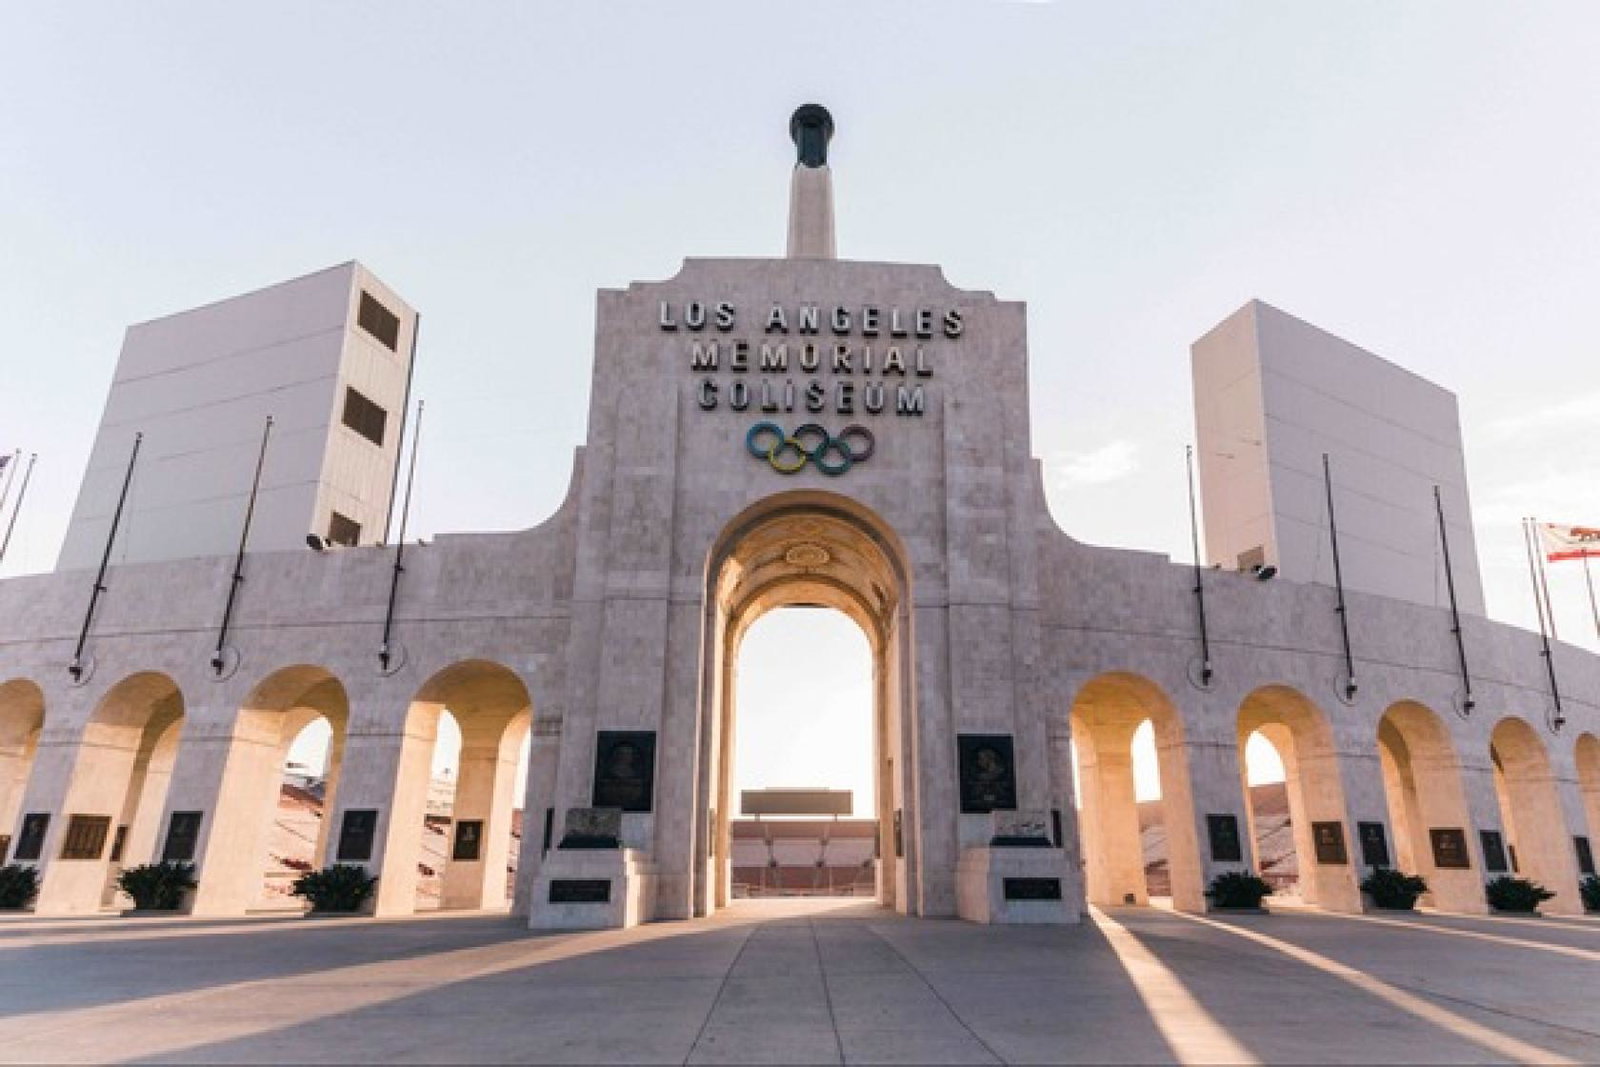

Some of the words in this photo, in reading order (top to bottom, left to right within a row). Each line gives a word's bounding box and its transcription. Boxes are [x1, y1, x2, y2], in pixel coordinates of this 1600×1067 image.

[660, 300, 735, 332] LOS
[765, 303, 963, 339] ANGELES
[691, 342, 933, 377] MEMORIAL
[698, 378, 924, 416] COLISEUM
